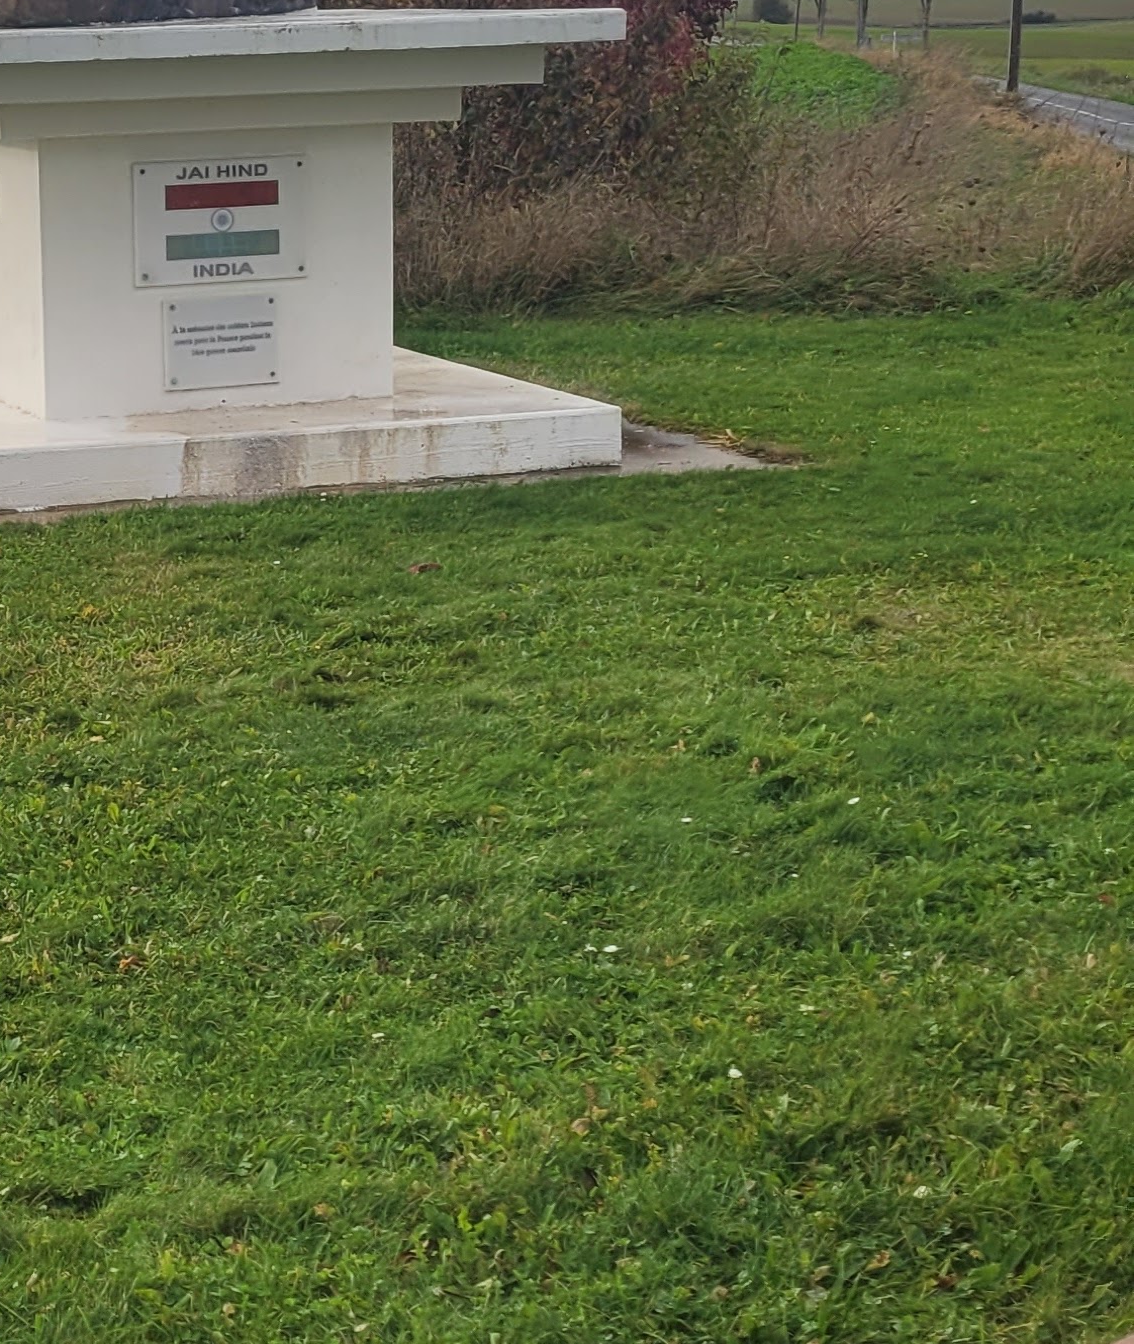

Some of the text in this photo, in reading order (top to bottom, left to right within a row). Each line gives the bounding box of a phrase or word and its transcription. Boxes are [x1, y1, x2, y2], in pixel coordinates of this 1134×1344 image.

[176, 163, 268, 180] JAI HIND
[193, 262, 254, 278] INDIA
